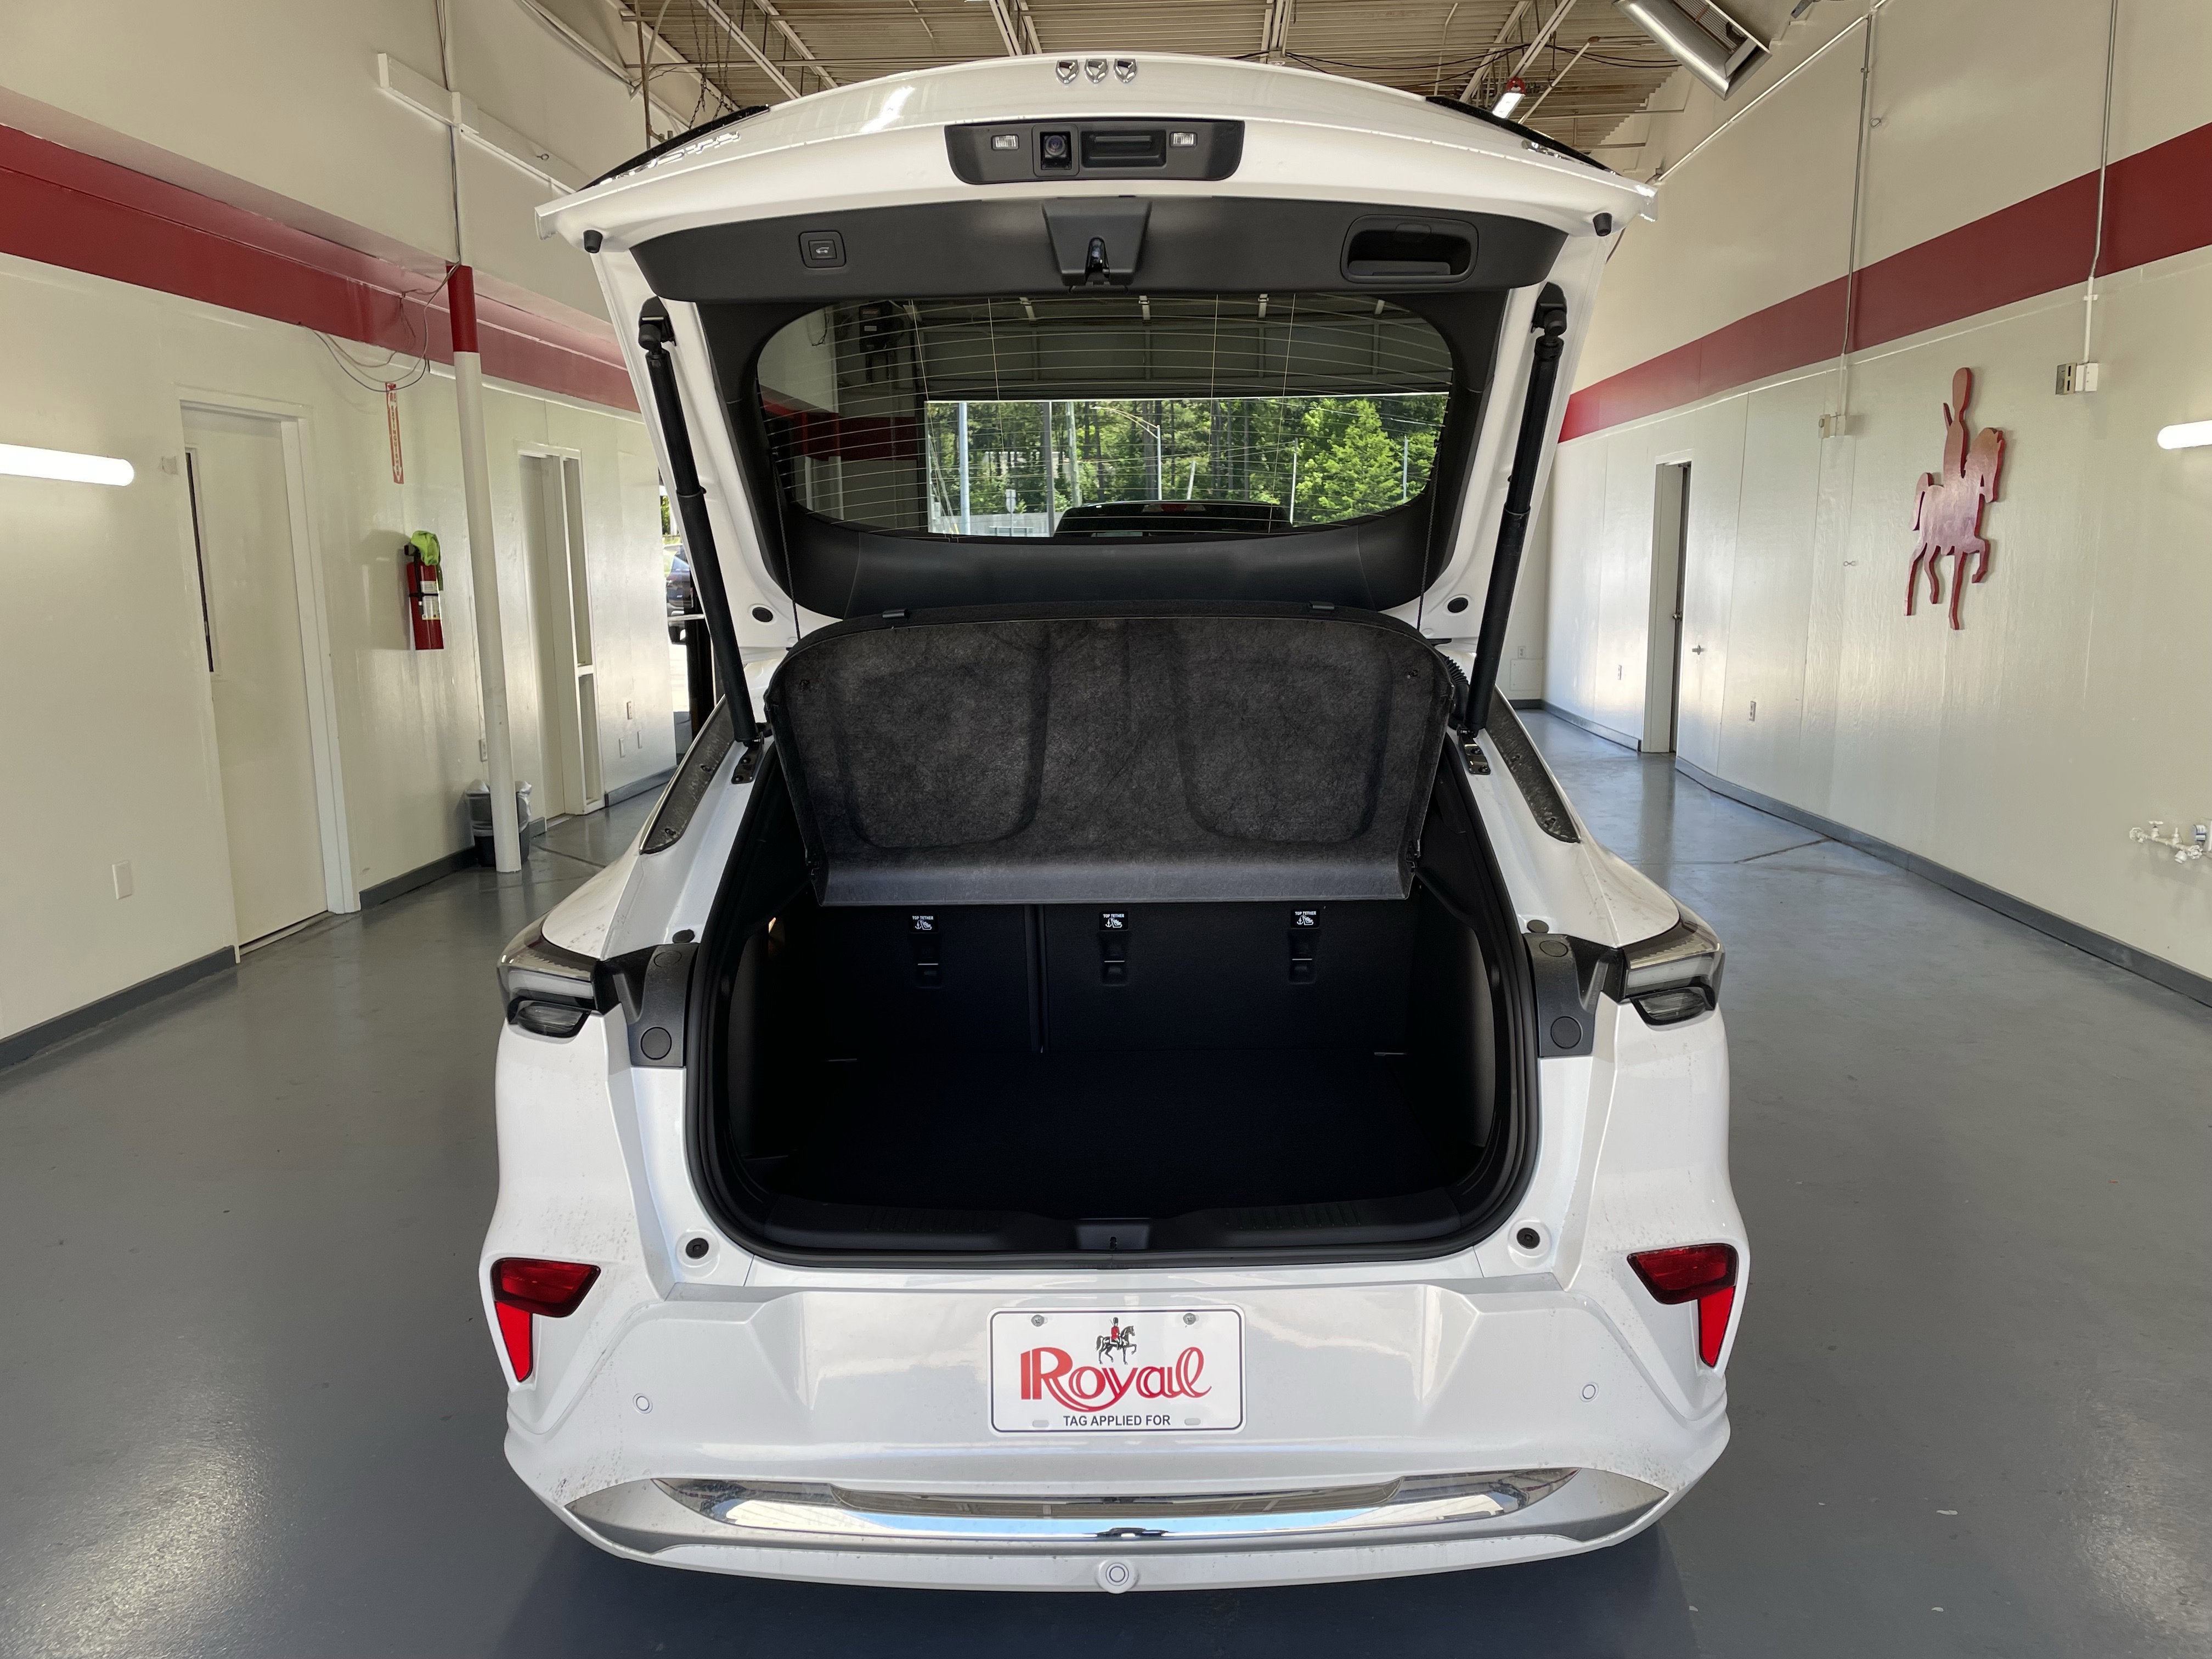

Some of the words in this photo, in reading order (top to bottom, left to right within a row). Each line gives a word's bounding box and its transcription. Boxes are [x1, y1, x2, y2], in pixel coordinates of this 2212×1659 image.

[1020, 1346, 1212, 1413] Royal
[1063, 1415, 1087, 1426] TAG
[1090, 1415, 1141, 1425] APPLIED
[1146, 1415, 1171, 1425] FOR
